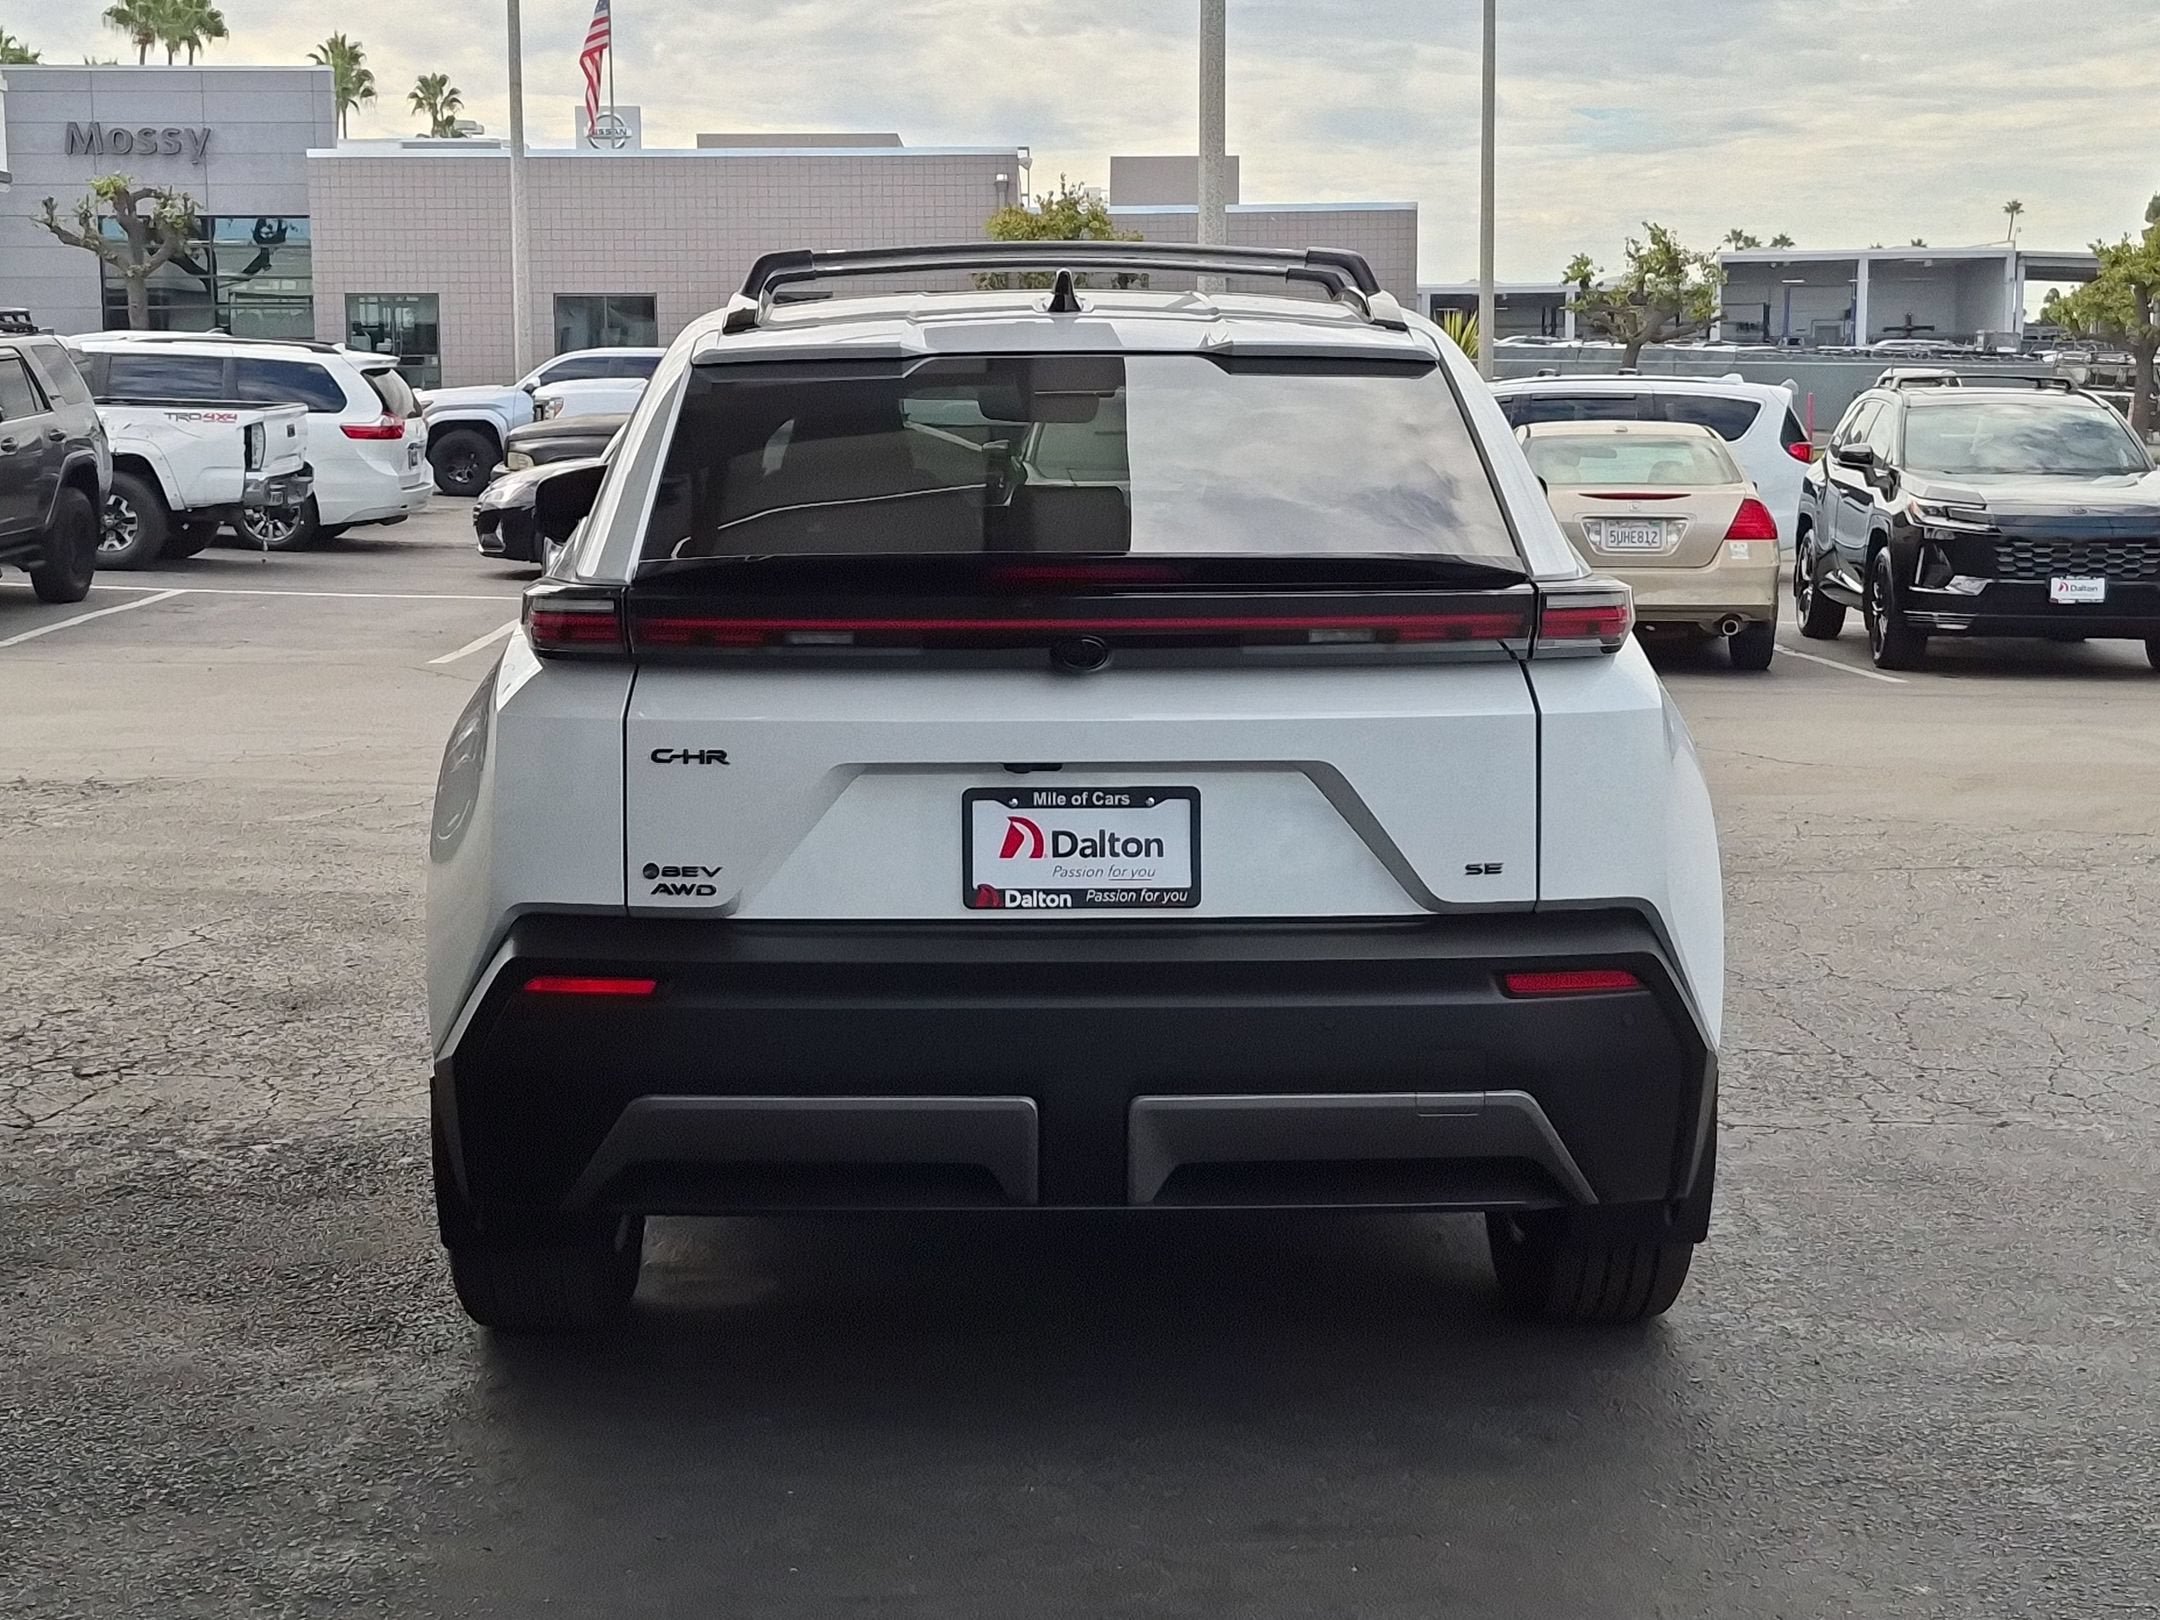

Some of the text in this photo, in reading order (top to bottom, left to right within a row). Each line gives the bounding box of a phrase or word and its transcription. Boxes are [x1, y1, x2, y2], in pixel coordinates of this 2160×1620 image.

[64, 121, 212, 165] Mossy
[163, 411, 202, 422] TRD
[1609, 530, 1658, 544] 5UHE812
[2070, 584, 2098, 592] Dalton
[650, 748, 731, 765] C-HR
[1033, 791, 1131, 806] Mile of Cars
[1051, 829, 1164, 859] Dalton
[661, 865, 724, 877] BEV
[1052, 864, 1156, 879] Passion for you
[1464, 862, 1504, 876] SE
[650, 883, 717, 896] AWD
[1085, 888, 1188, 904] Passion for you
[1004, 889, 1072, 908] Dalton
